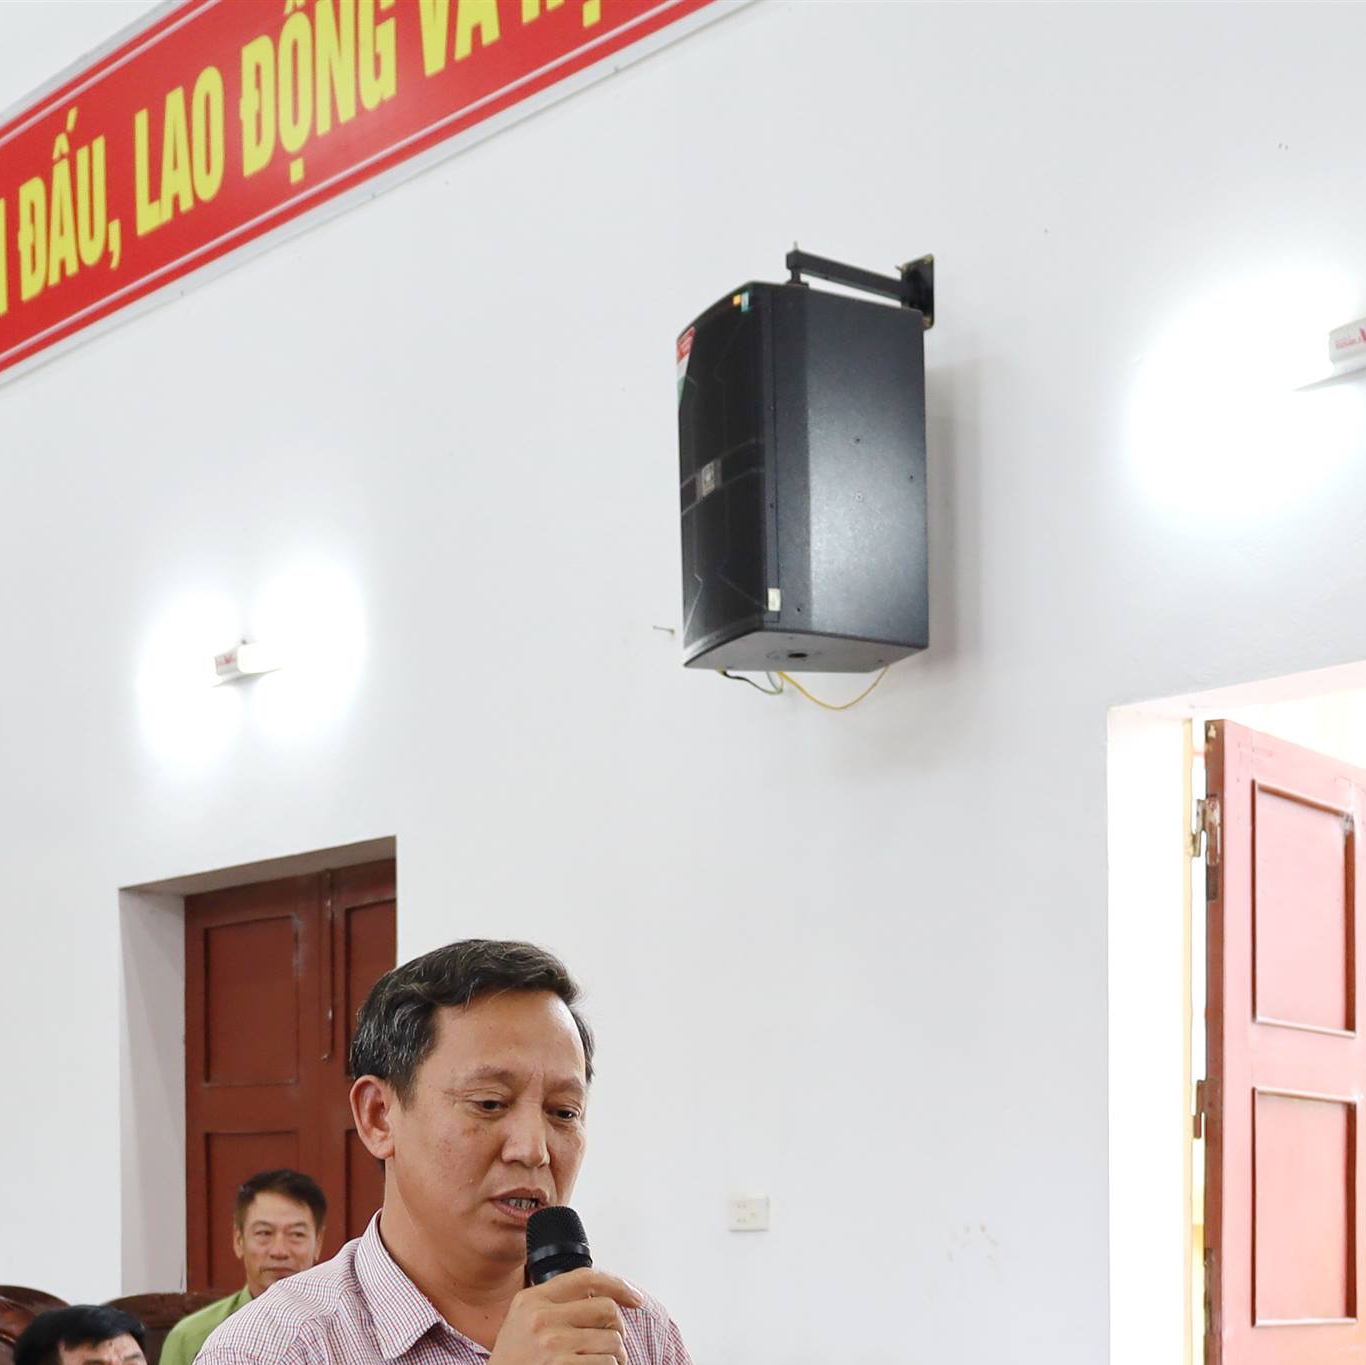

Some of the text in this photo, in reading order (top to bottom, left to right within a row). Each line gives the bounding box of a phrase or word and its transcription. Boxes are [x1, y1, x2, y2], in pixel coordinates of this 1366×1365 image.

[17, 106, 122, 302] ĐẤU,
[134, 65, 226, 237] LAO
[239, 0, 397, 185] ĐỘNG
